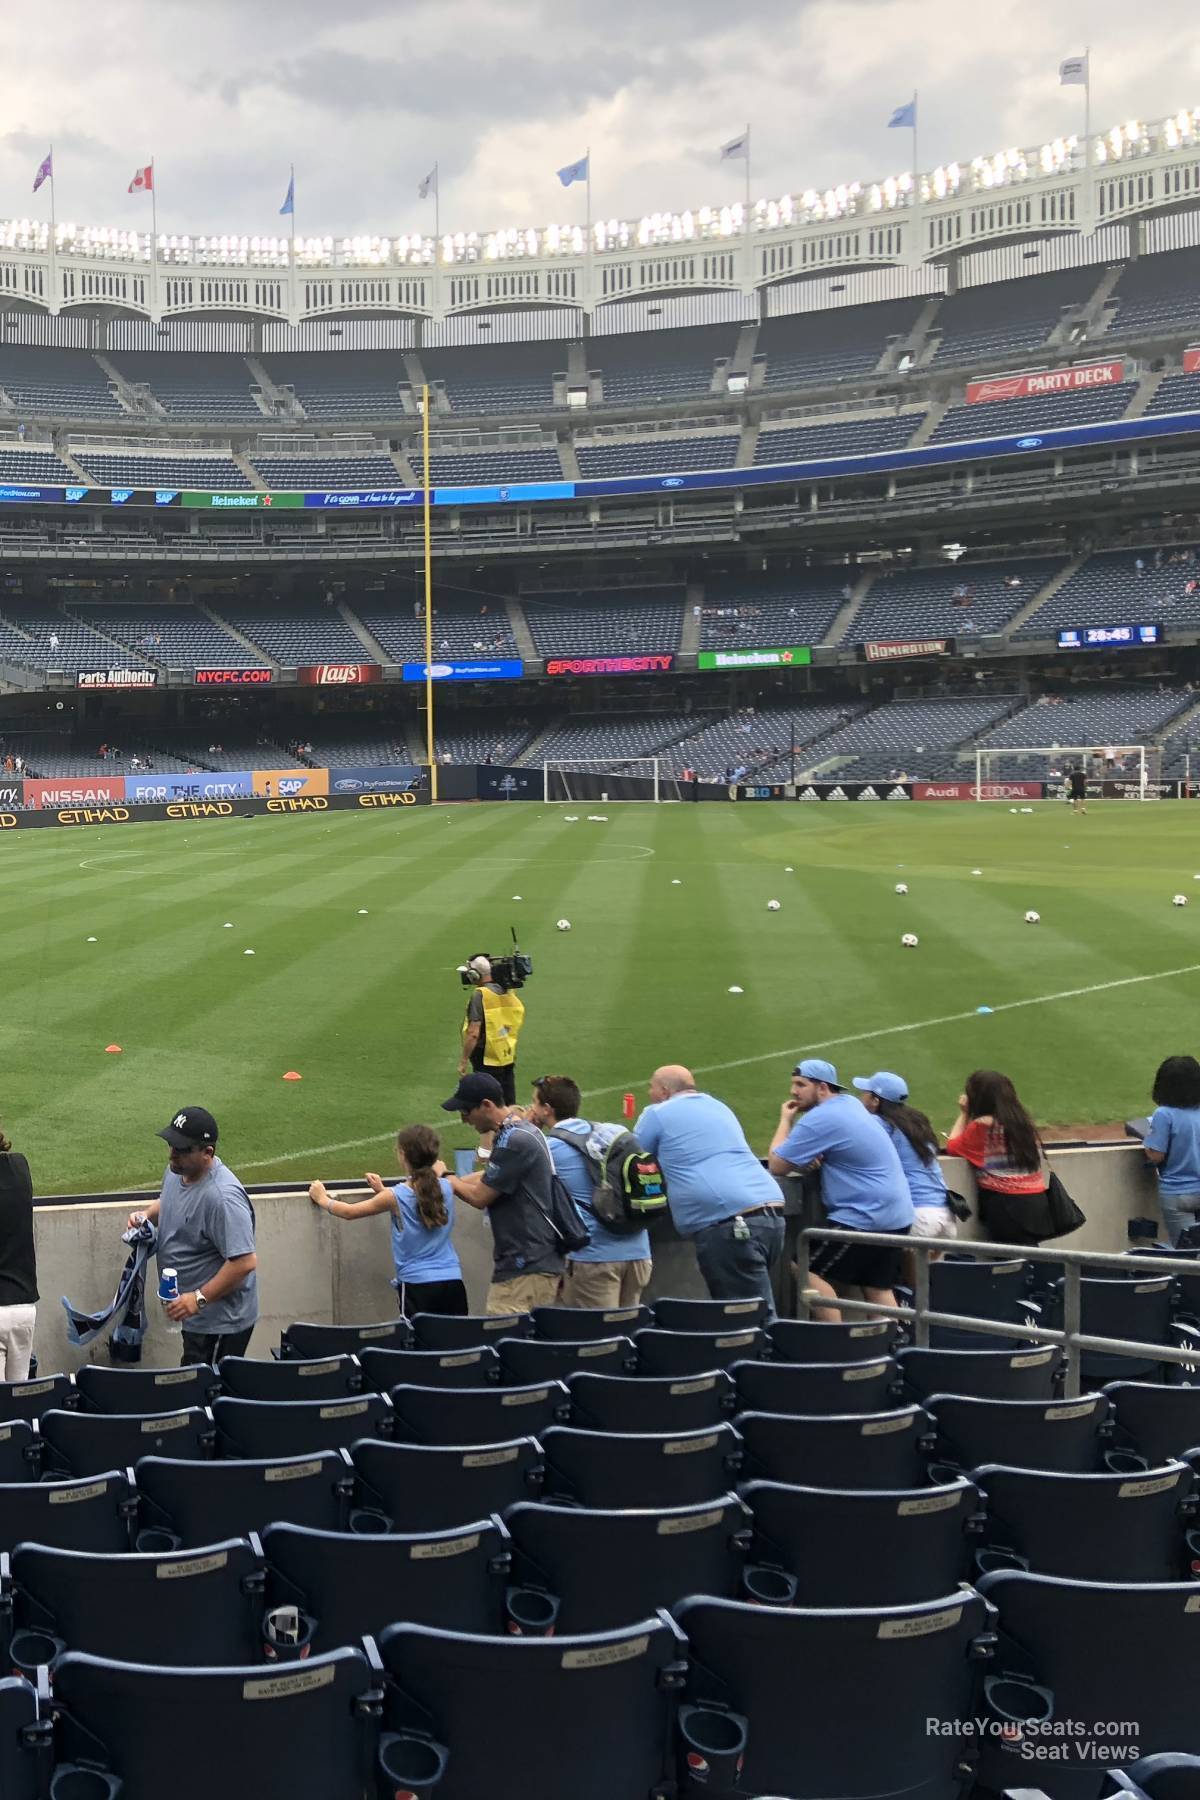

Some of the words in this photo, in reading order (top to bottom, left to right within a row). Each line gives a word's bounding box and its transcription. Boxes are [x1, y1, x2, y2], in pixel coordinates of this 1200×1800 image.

[1027, 373, 1072, 392] PARTY
[1075, 367, 1113, 385] DECK
[66, 489, 83, 501] SAP
[111, 491, 128, 502] SAP
[155, 492, 173, 504] SAP
[211, 495, 258, 506] Heineken
[1087, 628, 1131, 641] 28:45
[547, 656, 672, 674] #FORTHECITY
[715, 652, 780, 666] Heineken
[78, 671, 107, 684] Parts
[108, 668, 156, 683] Authority
[196, 670, 271, 684] NYCFC.COM
[136, 786, 167, 798] FOR
[171, 785, 200, 797] THE
[204, 784, 237, 796] CITY
[278, 780, 303, 793] SAP
[925, 785, 960, 797] Audi
[41, 789, 110, 801] NISSAN
[358, 792, 417, 807] ETIHAD
[166, 801, 233, 818] ETIHAD
[266, 797, 329, 812] ETIHAD
[57, 807, 130, 824] ETIHAD
